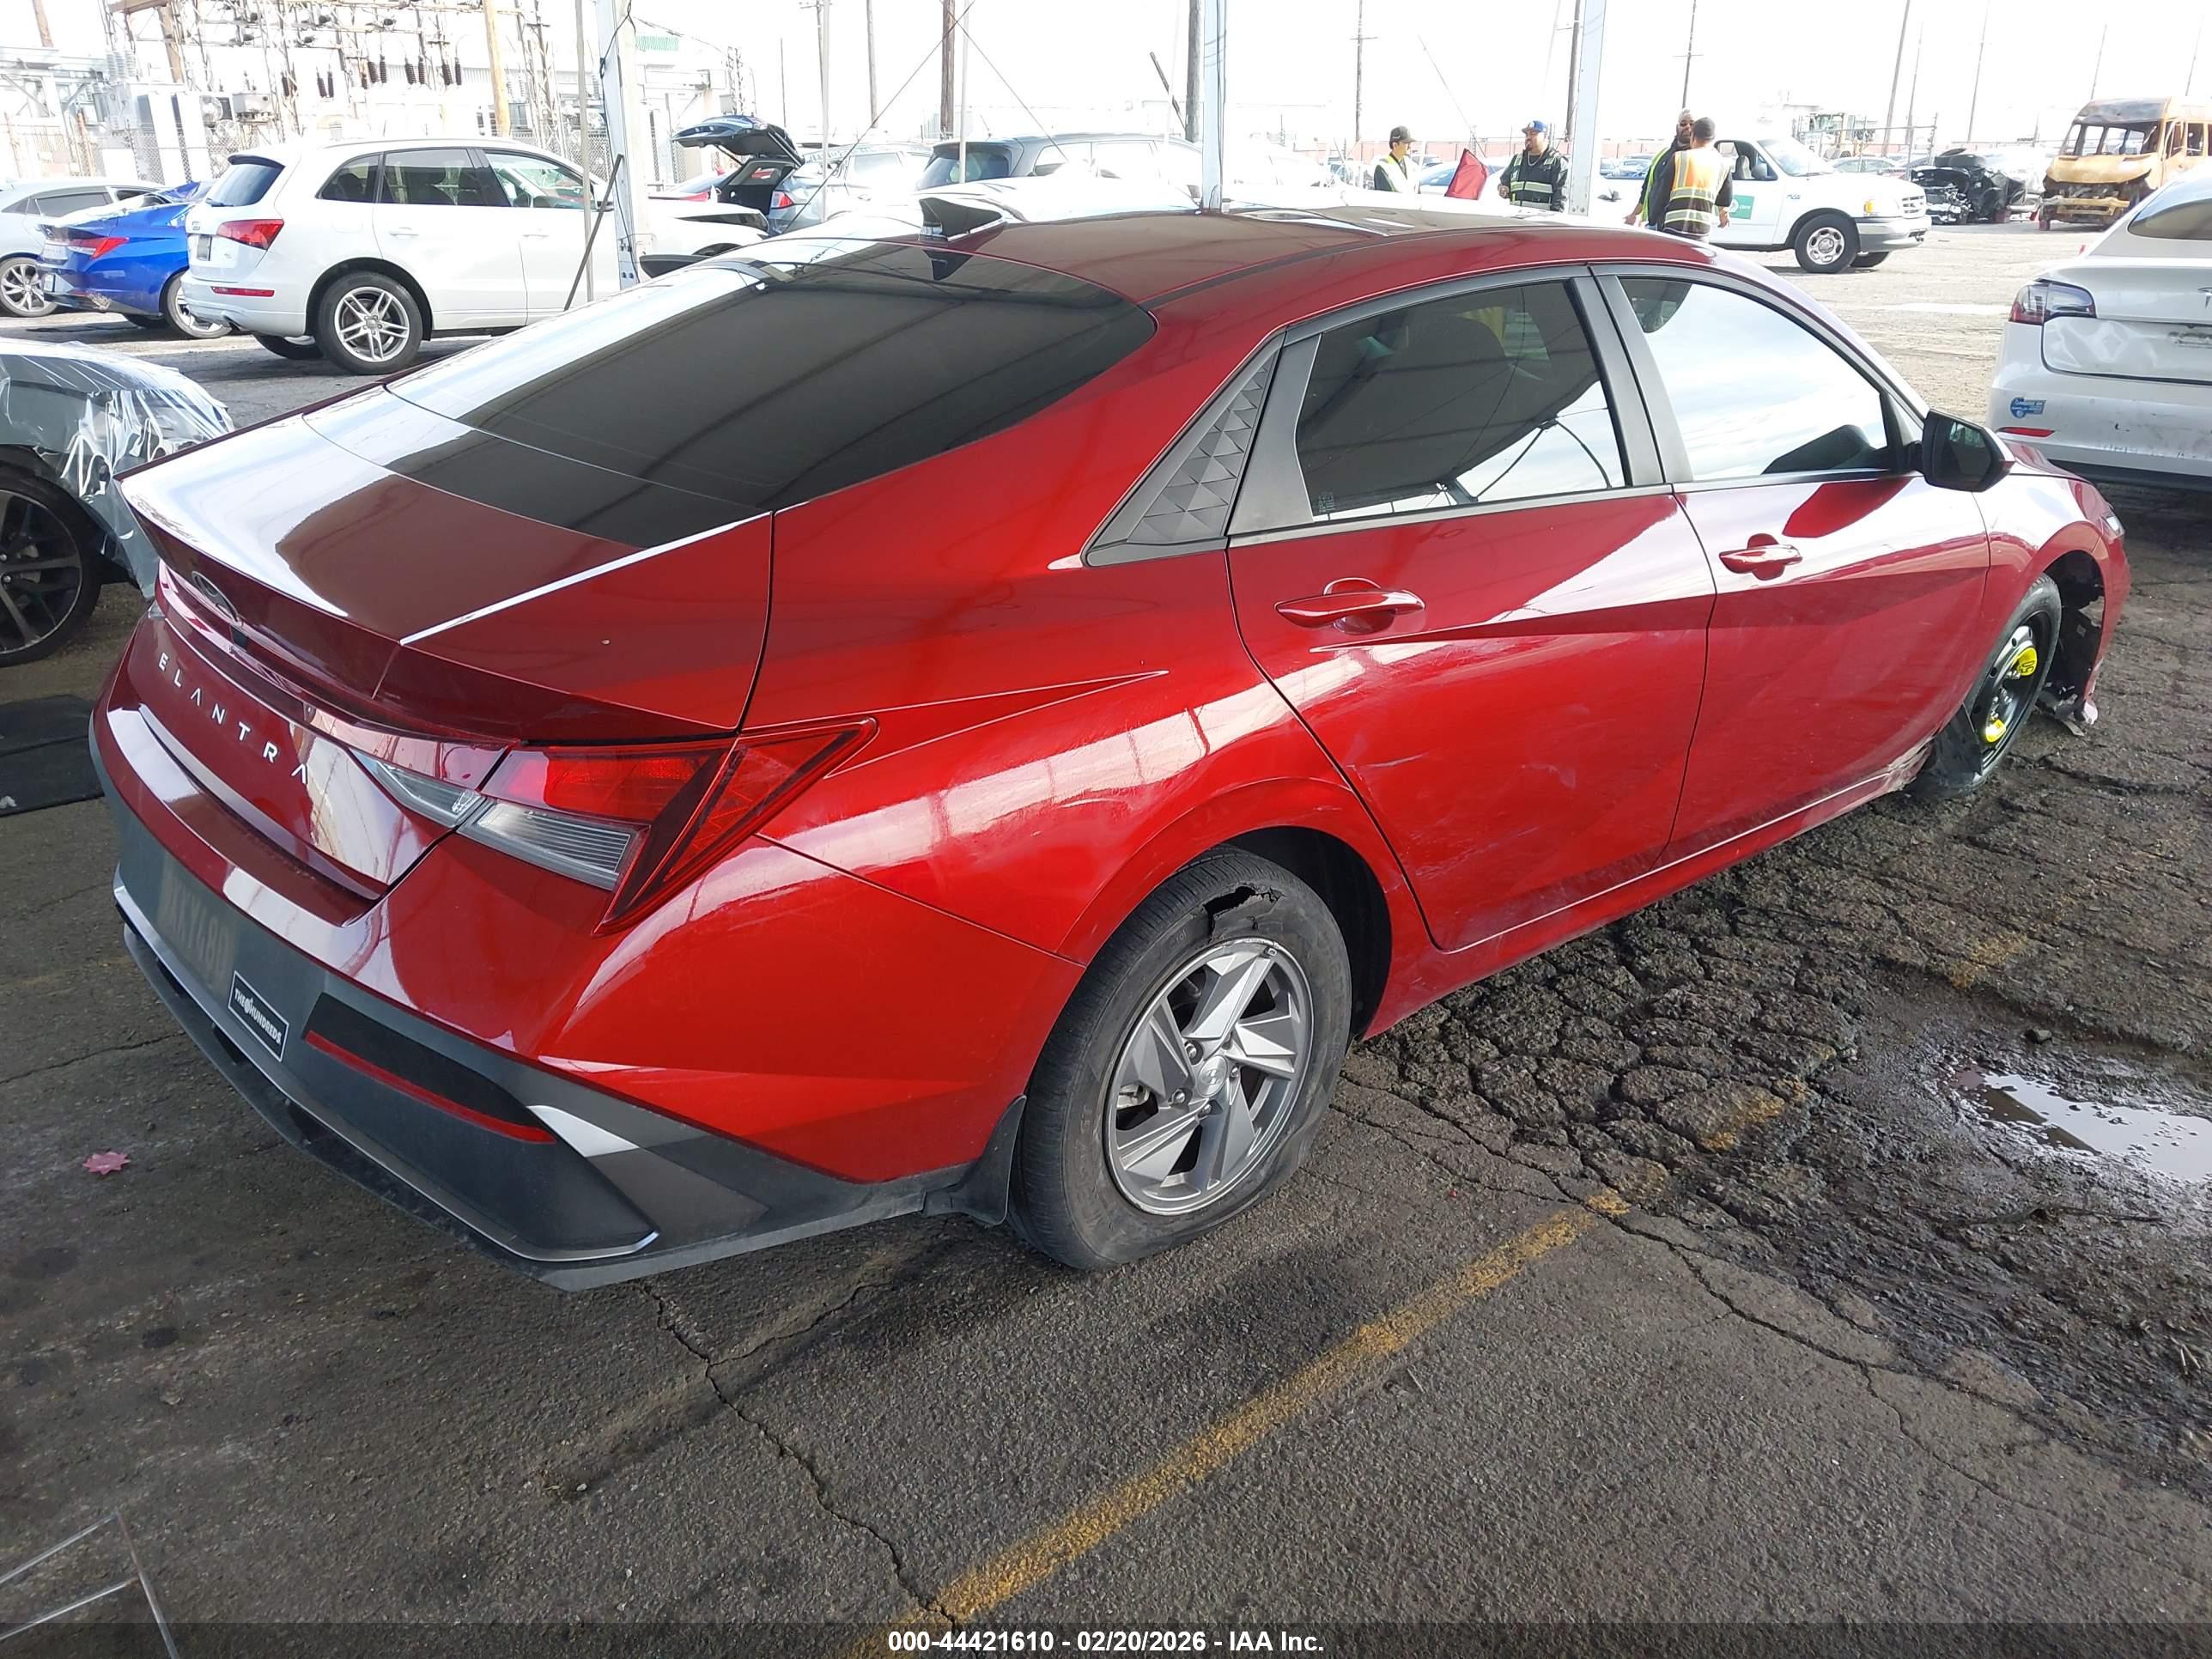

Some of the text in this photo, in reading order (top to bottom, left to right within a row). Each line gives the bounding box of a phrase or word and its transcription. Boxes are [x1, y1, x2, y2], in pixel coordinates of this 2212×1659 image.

[158, 652, 309, 785] ELANTRA
[234, 988, 283, 1044] THE HUNDREDS
